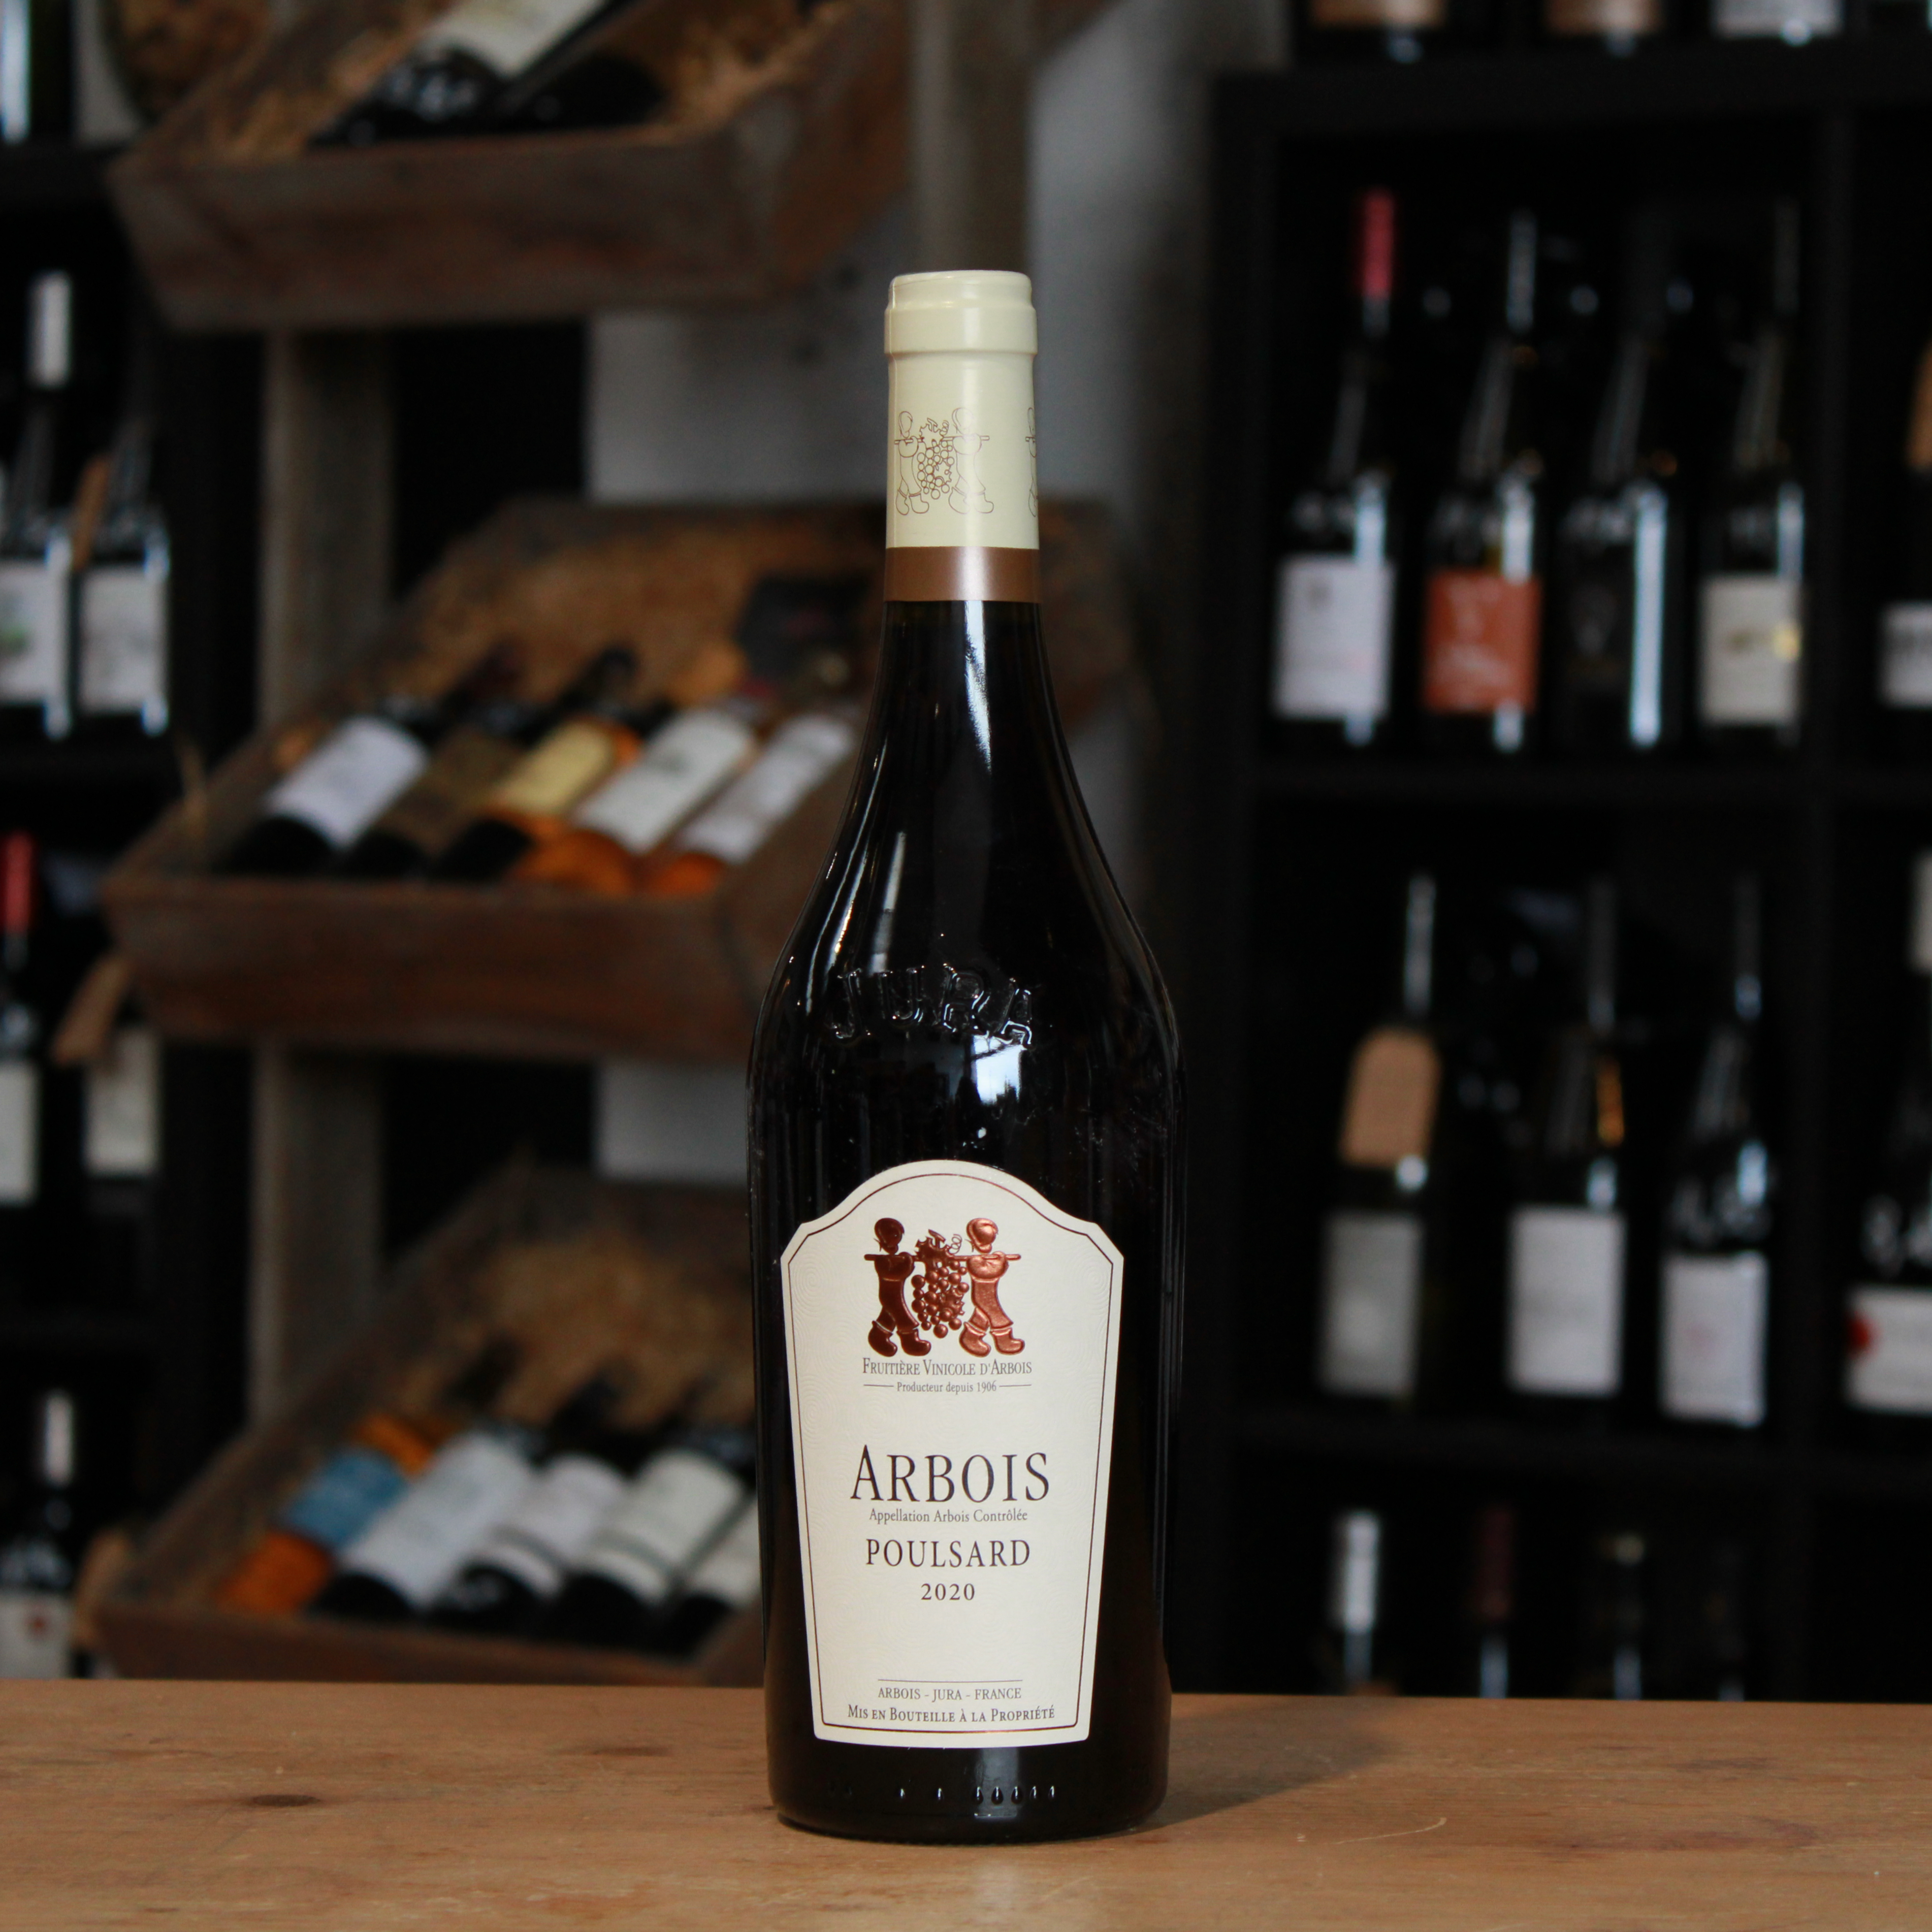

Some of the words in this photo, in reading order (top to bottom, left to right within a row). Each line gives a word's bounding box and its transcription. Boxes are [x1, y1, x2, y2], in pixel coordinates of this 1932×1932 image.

[827, 963, 1033, 1046] JURA
[863, 1356, 920, 1375] FRUITIÈRE
[923, 1359, 976, 1376] VINICOLE
[980, 1358, 1032, 1375] D'ARBOIS
[897, 1381, 943, 1392] Producteur
[945, 1381, 973, 1395] depuis
[977, 1380, 997, 1393] 1906
[850, 1444, 1049, 1503] ARBOIS
[869, 1508, 930, 1525] Appellation
[934, 1509, 969, 1522] Arbois
[973, 1508, 1028, 1522] Contrôlée
[866, 1539, 1030, 1568] POULSARD
[921, 1583, 975, 1601] 2020
[878, 1687, 921, 1700] ARBOIS
[932, 1689, 962, 1703] JURA
[975, 1687, 1022, 1700] FRANCE
[848, 1704, 868, 1719] MIS
[871, 1709, 886, 1720] EN
[890, 1707, 955, 1722] BOUTEILLE
[959, 1708, 967, 1722] À
[971, 1712, 986, 1722] LA
[991, 1705, 1055, 1722] PROPRIÉTÉ
